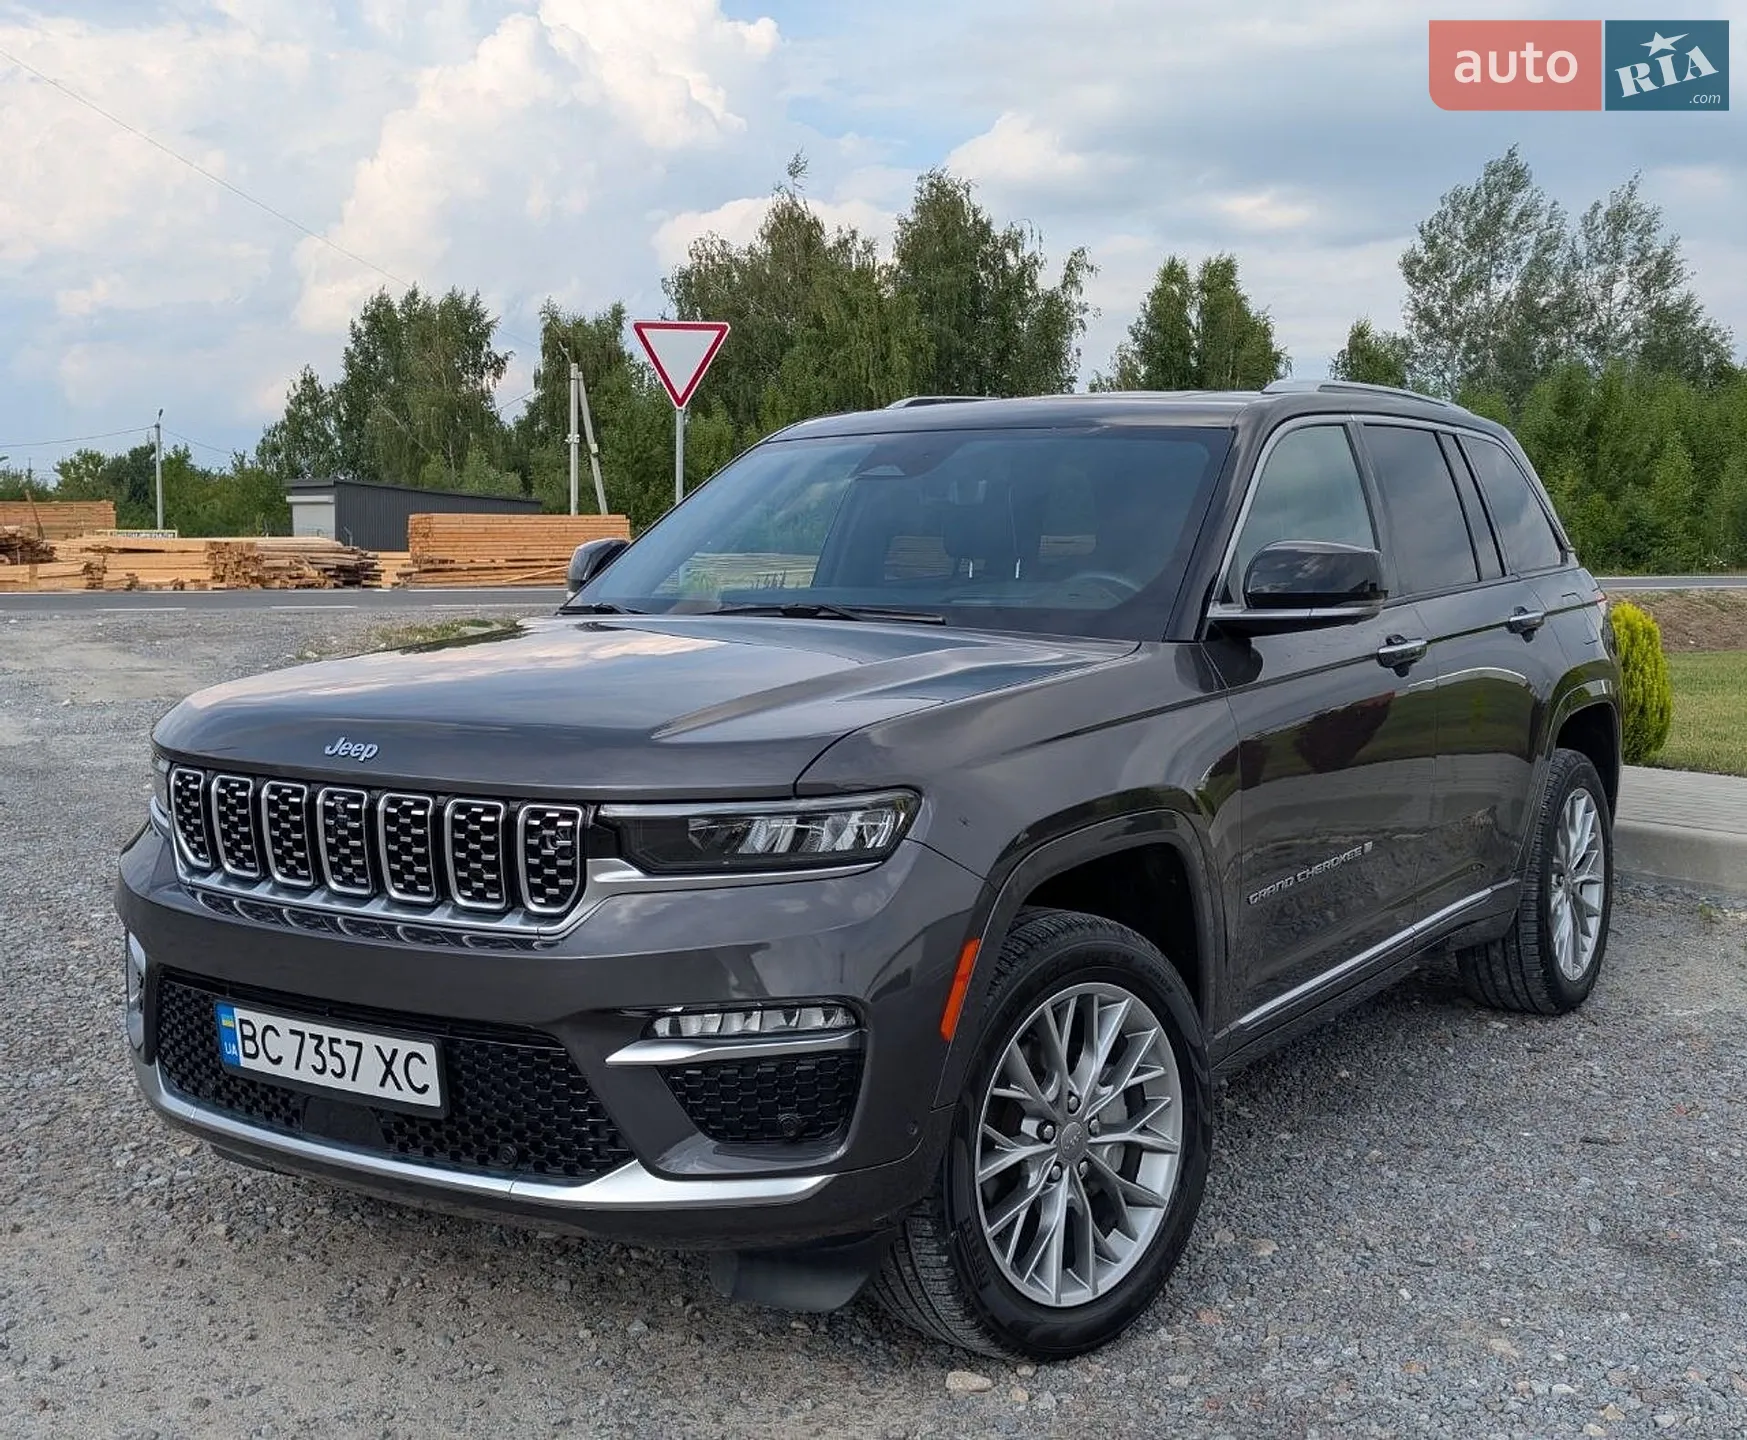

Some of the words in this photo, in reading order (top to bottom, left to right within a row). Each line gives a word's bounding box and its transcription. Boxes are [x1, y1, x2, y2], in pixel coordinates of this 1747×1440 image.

[324, 736, 379, 762] Jeep
[1248, 875, 1295, 905] GRAND
[1296, 845, 1363, 883] CHEROKEE
[224, 1040, 238, 1057] UA
[238, 1018, 283, 1066] BC
[289, 1028, 364, 1082] 7357
[374, 1044, 430, 1095] XC
